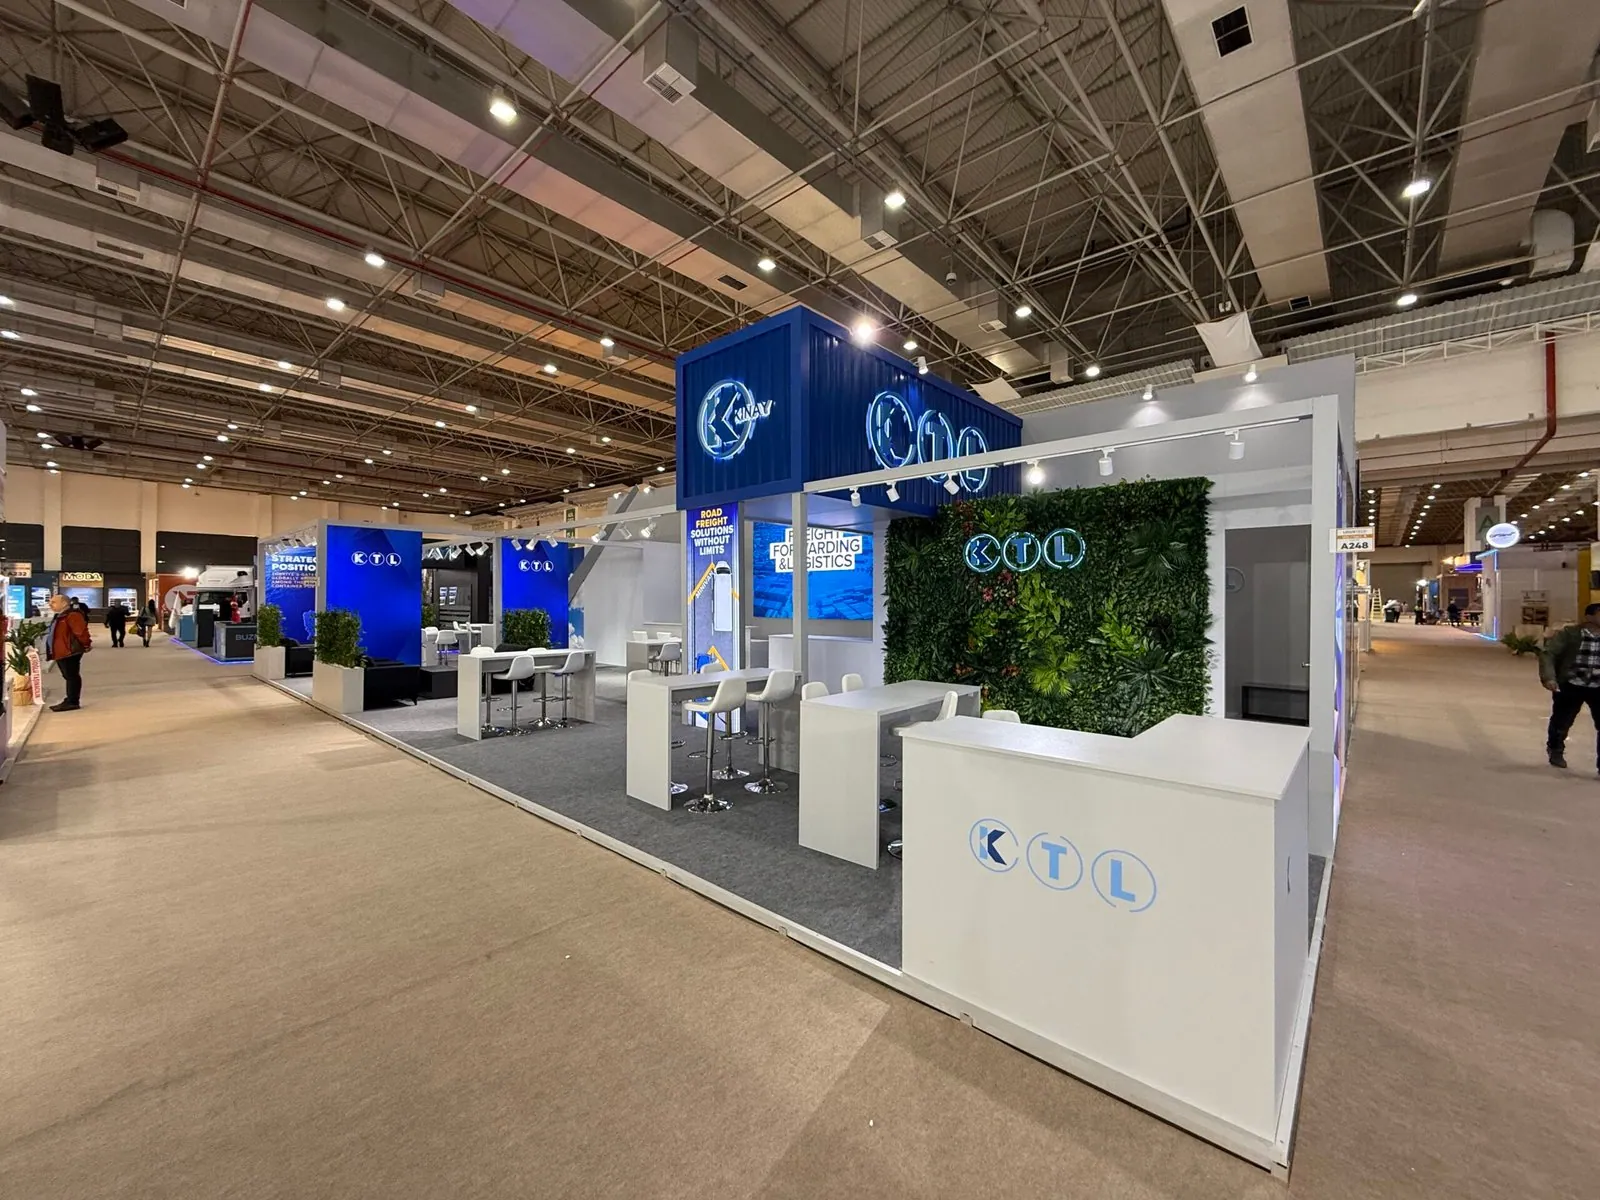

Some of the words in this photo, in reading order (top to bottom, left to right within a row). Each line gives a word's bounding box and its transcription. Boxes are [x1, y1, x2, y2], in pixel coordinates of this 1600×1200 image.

[701, 508, 722, 519] ROAD
[696, 516, 728, 529] FREIGHT
[690, 525, 734, 539] SOLUTIONS
[694, 535, 730, 547] WITHOUT
[773, 538, 860, 557] FOARDING
[1341, 542, 1369, 550] A248
[700, 545, 725, 555] LIMITS
[353, 552, 400, 566] KTL
[779, 554, 853, 570] &LGISTICS
[519, 560, 552, 572] KTL
[975, 822, 1147, 906] KTL
